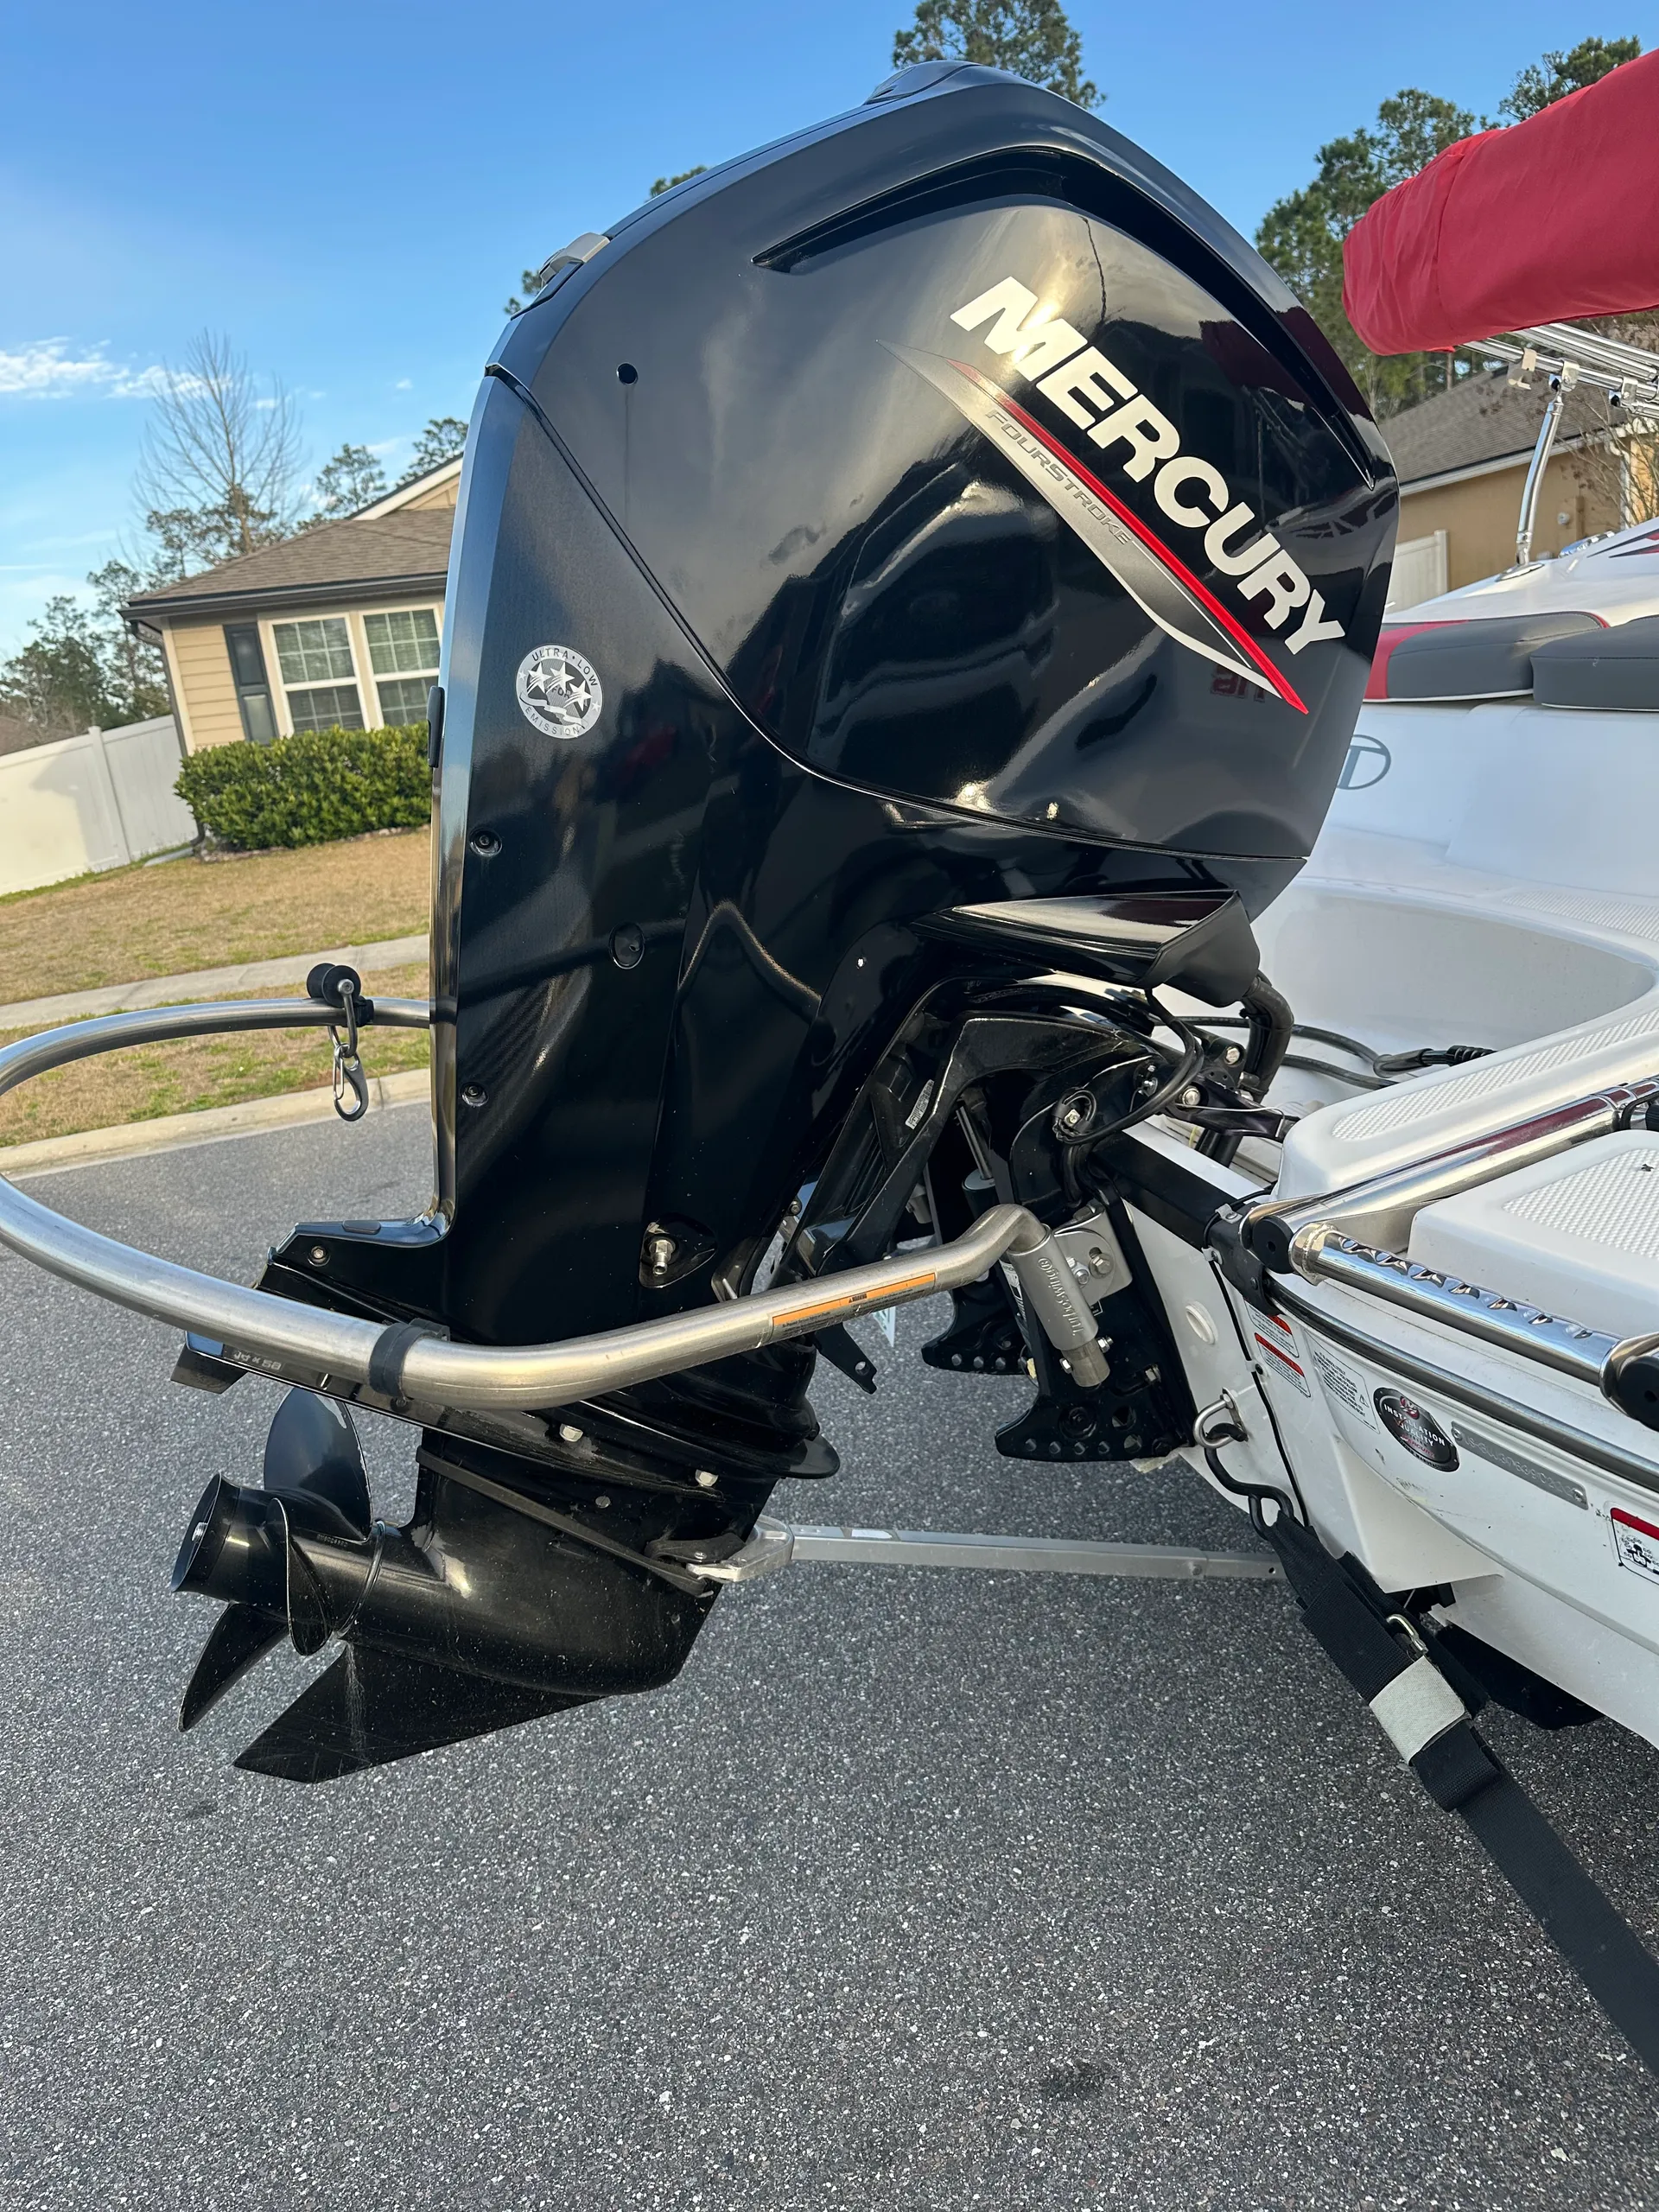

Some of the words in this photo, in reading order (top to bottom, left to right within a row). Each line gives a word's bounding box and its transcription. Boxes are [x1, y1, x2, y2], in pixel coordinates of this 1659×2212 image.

[950, 276, 1345, 655] MERCURY
[986, 410, 1131, 544] FOURSTROKE
[532, 648, 569, 662] ULTRA
[577, 659, 598, 687] LOW
[525, 706, 580, 736] EMISSION
[1383, 1404, 1446, 1446] INSTALLATION
